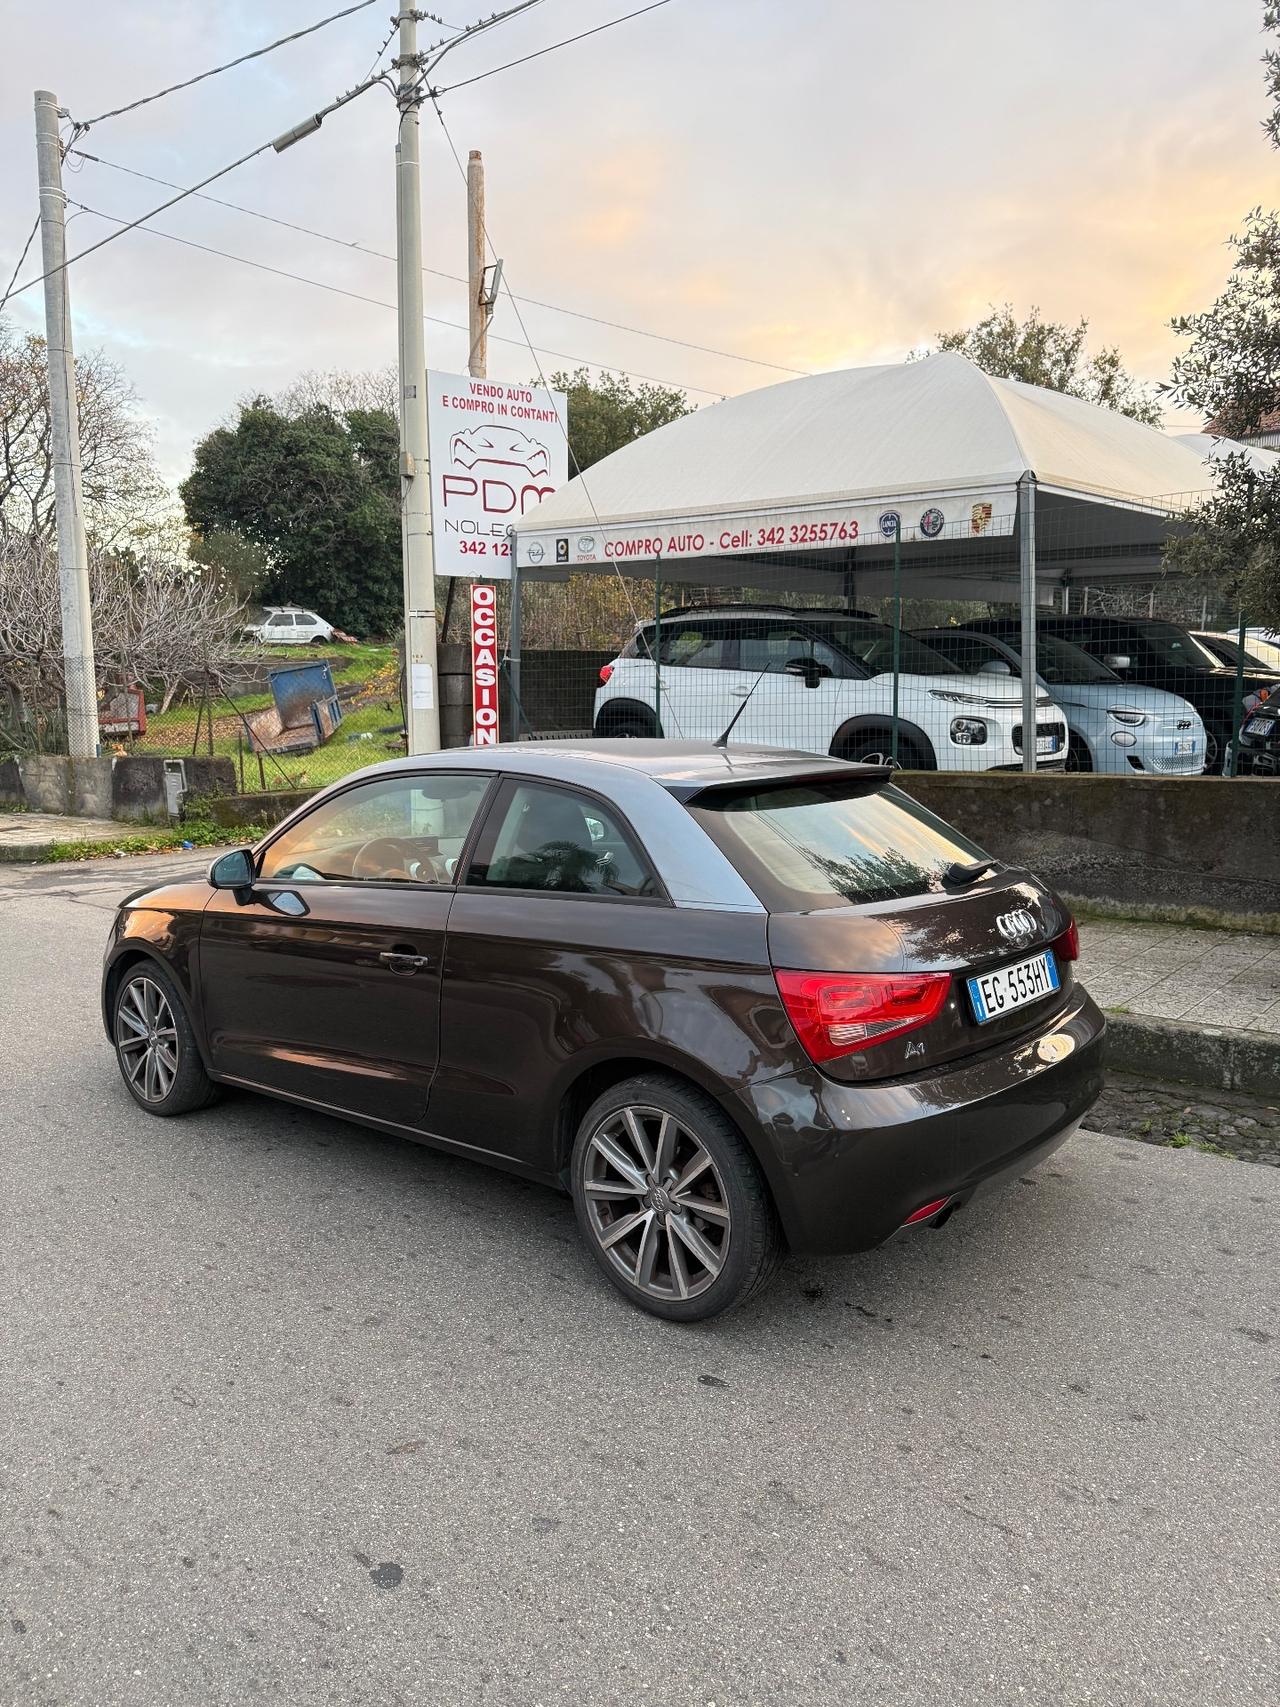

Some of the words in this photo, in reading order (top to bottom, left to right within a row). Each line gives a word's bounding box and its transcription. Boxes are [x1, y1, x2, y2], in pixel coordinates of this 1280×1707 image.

[469, 382, 504, 399] VENDO
[506, 388, 532, 403] AUTO
[442, 395, 449, 407] E
[452, 396, 495, 414] COMPRO
[497, 403, 508, 416] IN
[510, 405, 559, 423] CONTANTI
[459, 540, 487, 555] 342
[604, 537, 663, 557] COMPRO
[667, 533, 705, 553] AUTO
[719, 529, 753, 549] Cell:
[757, 526, 785, 546] 342
[789, 520, 859, 543] 3255763
[577, 553, 597, 561] TOYOTA
[980, 976, 1004, 1014] EG
[1008, 957, 1050, 1003] 553HY
[904, 1041, 926, 1059] A1
